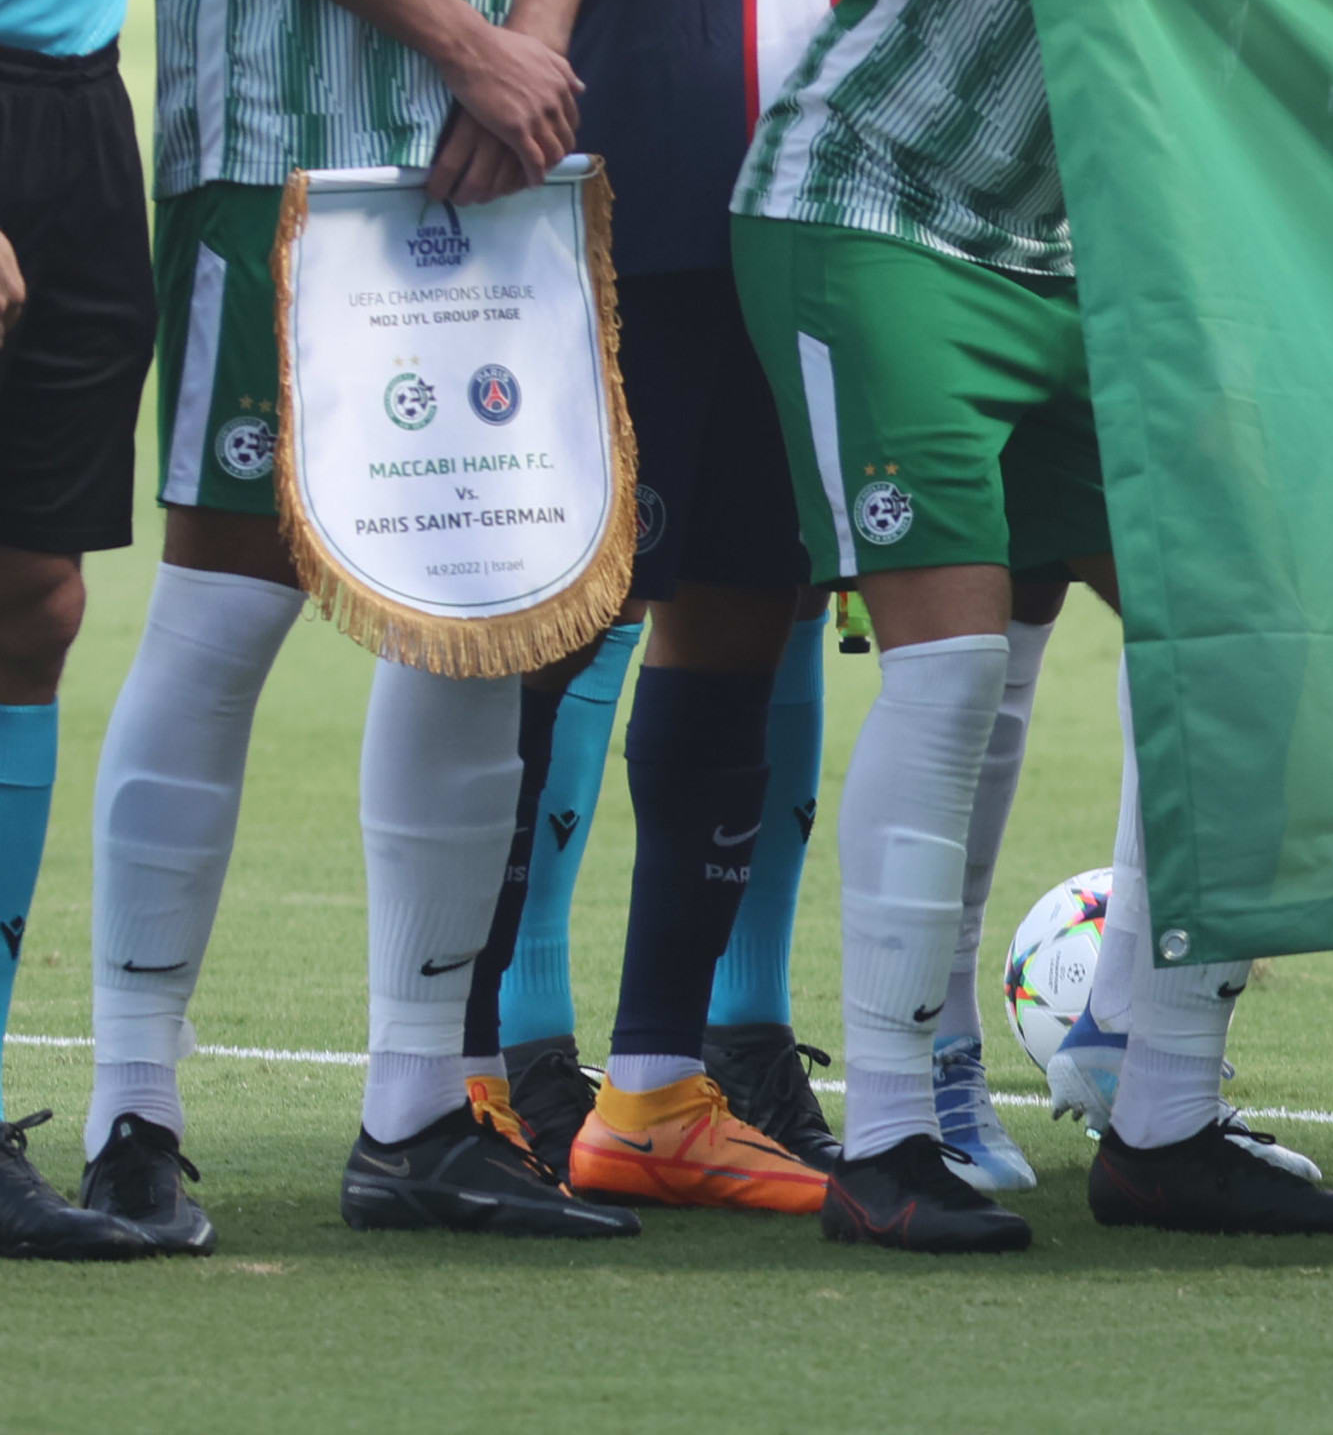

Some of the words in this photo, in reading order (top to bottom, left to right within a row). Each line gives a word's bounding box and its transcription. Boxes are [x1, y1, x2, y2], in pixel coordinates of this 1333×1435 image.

[417, 226, 448, 238] UEFA
[406, 237, 470, 256] YOUTH
[416, 255, 462, 268] LEAGUE
[348, 291, 385, 307] UEFA
[388, 285, 480, 306] CHAMPIONS
[483, 284, 536, 301] LEAGUE
[369, 314, 399, 327] MD2
[402, 312, 430, 326] UYL
[433, 309, 480, 324] GROUP
[483, 307, 521, 321] STAGE
[369, 458, 457, 479] MACCABI
[462, 454, 521, 473] HAIFA
[526, 453, 555, 469] F.C.
[455, 486, 480, 501] Vs.
[355, 517, 409, 536] PARIS
[415, 507, 566, 532] SAINT-GERMAIN
[491, 557, 526, 573] Israel
[704, 863, 751, 883] PAR
